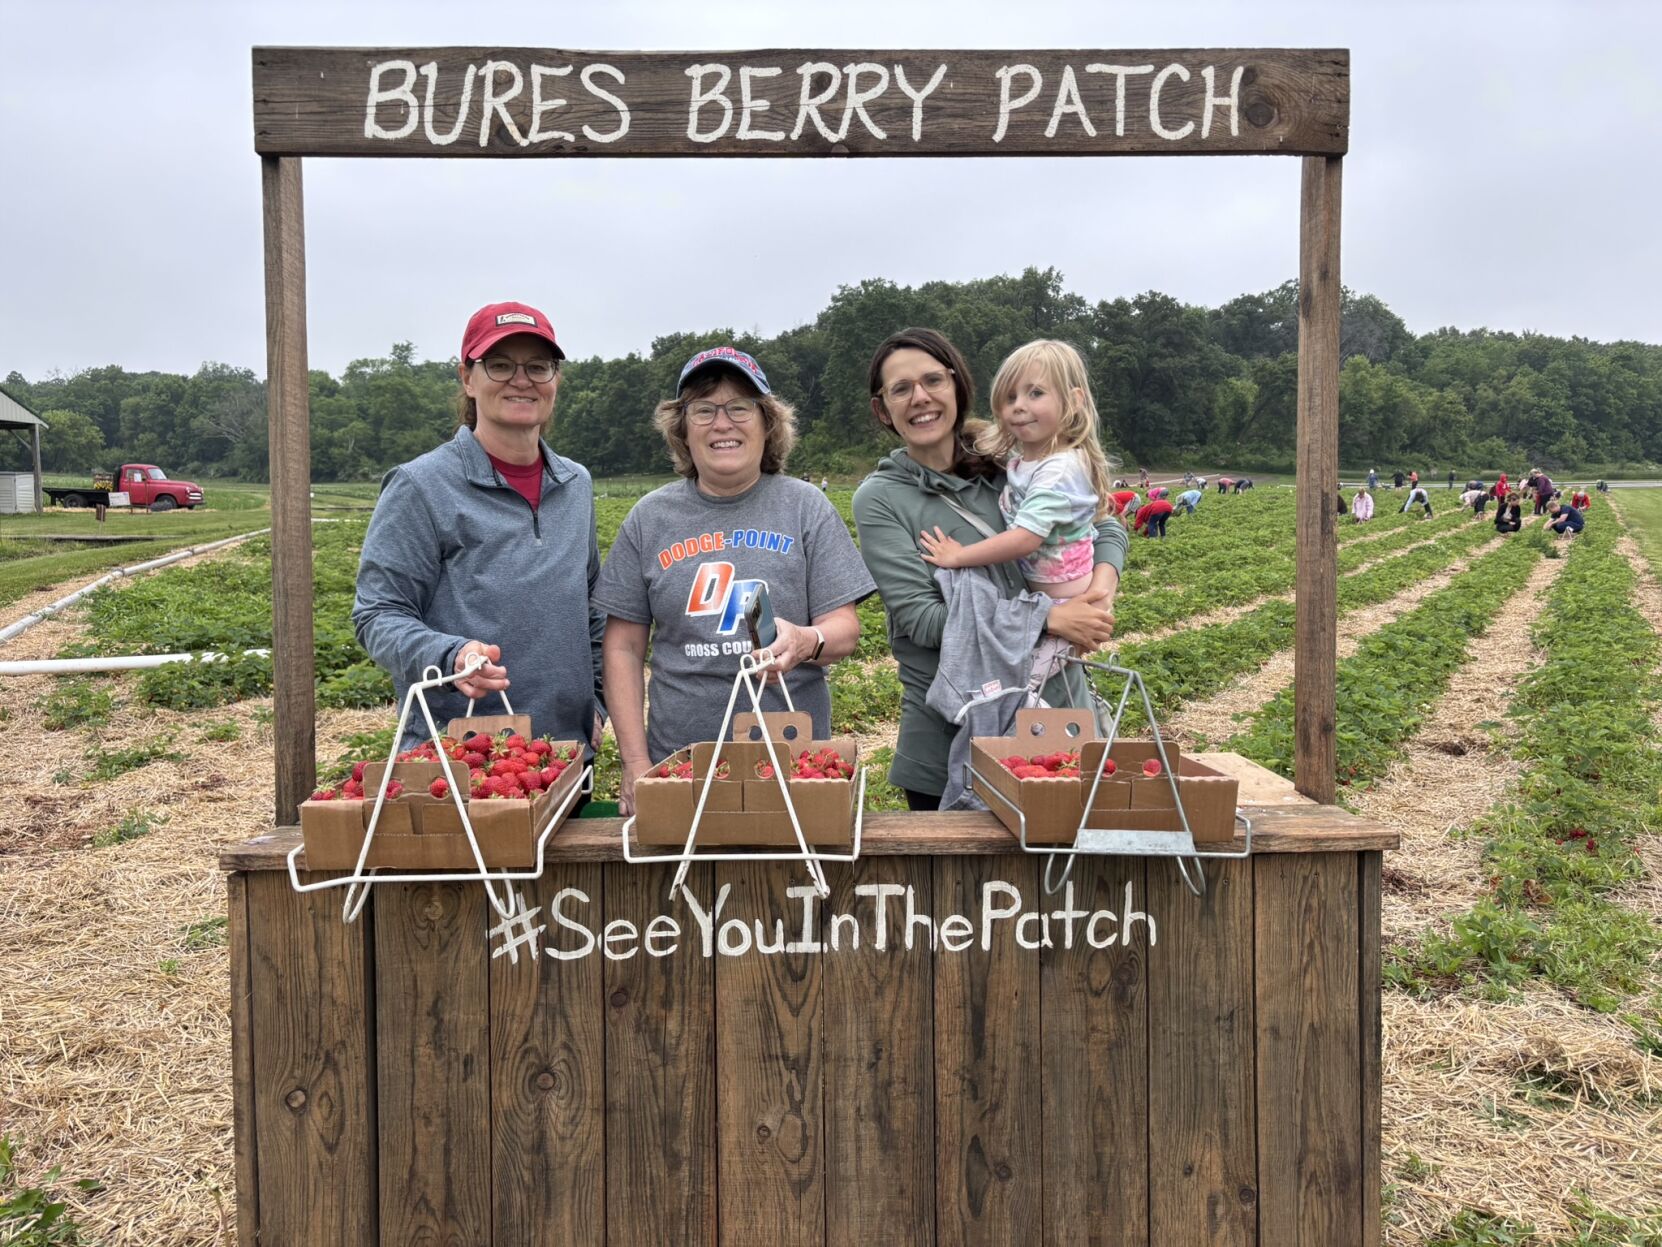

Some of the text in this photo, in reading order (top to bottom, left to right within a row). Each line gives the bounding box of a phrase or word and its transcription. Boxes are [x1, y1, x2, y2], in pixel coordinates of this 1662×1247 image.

[364, 59, 1244, 147] BURES BERRY PATCH
[658, 529, 794, 570] DODGE-POINT
[684, 643, 719, 657] CROSS
[486, 880, 1157, 964] #SeeYouInThePatch
